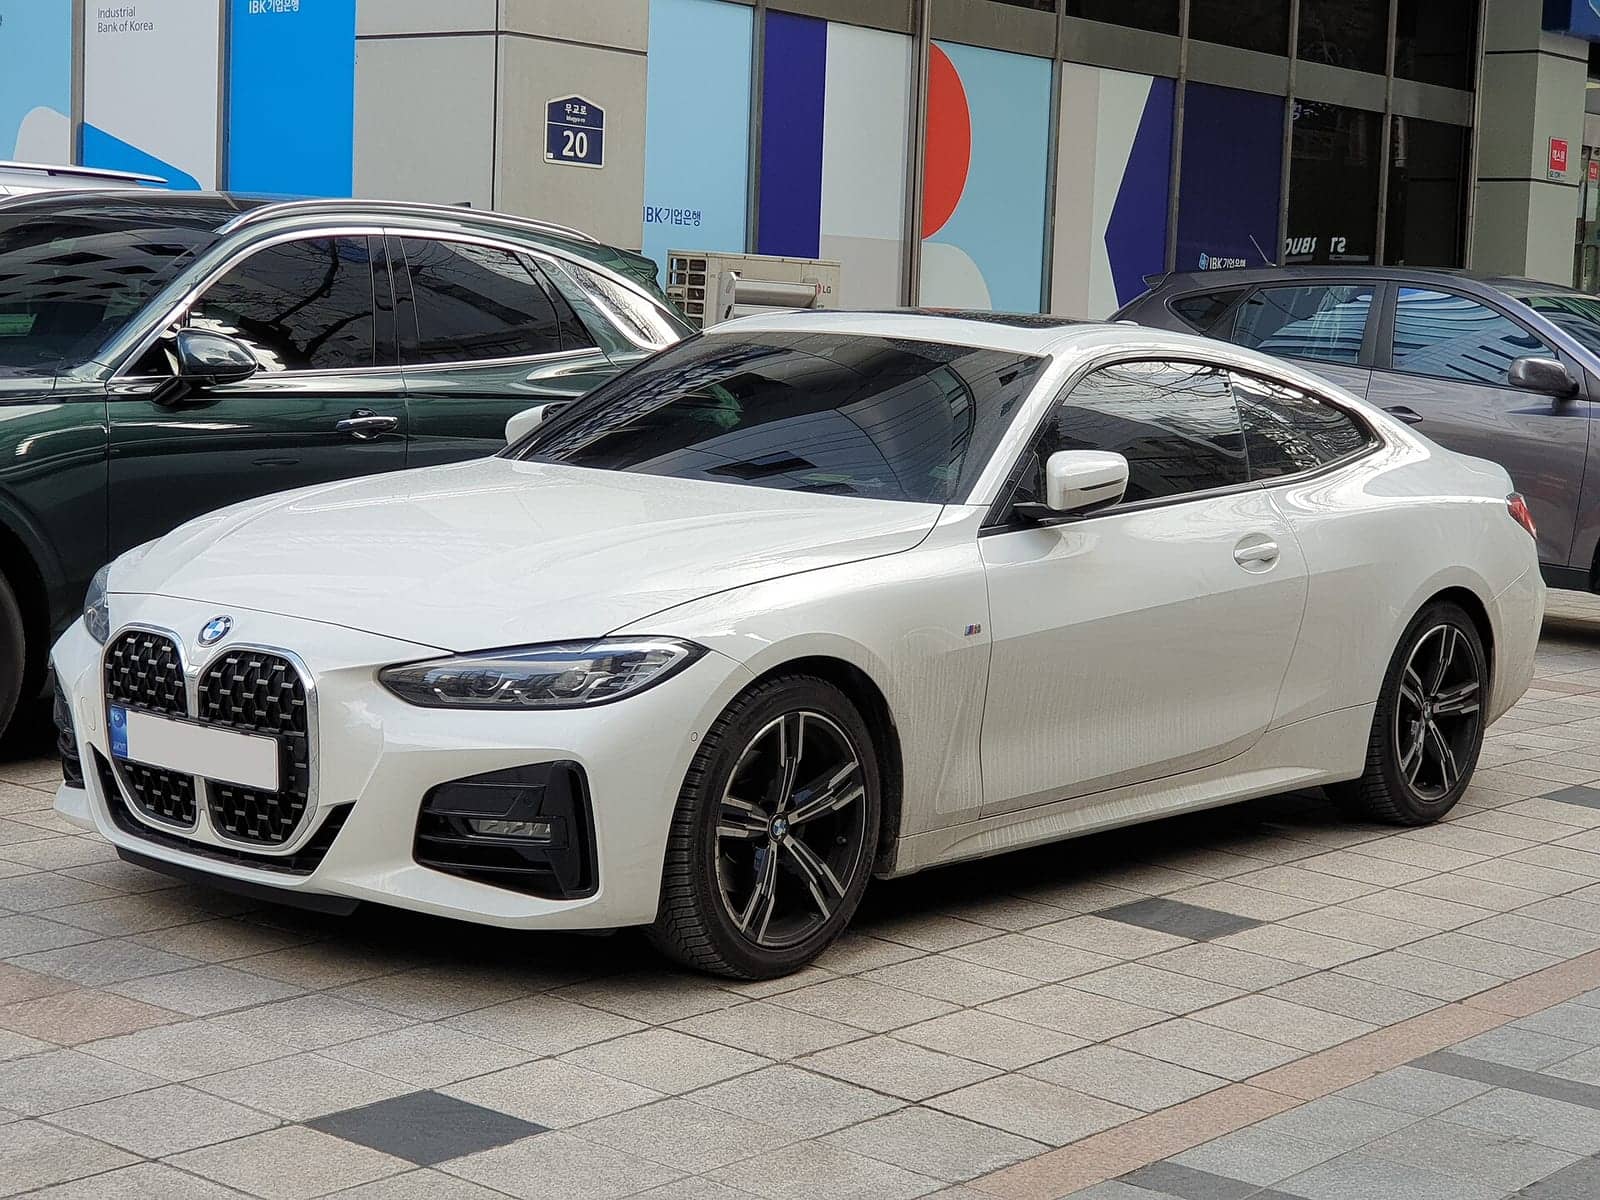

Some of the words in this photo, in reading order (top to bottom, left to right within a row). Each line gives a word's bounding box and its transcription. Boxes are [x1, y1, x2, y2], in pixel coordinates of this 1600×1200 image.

[97, 7, 136, 18] Industrial
[97, 22, 118, 33] Bank
[119, 20, 128, 32] of
[129, 21, 154, 32] Korea
[565, 103, 587, 115] 무교로
[562, 130, 588, 158] 20
[822, 285, 831, 293] LG
